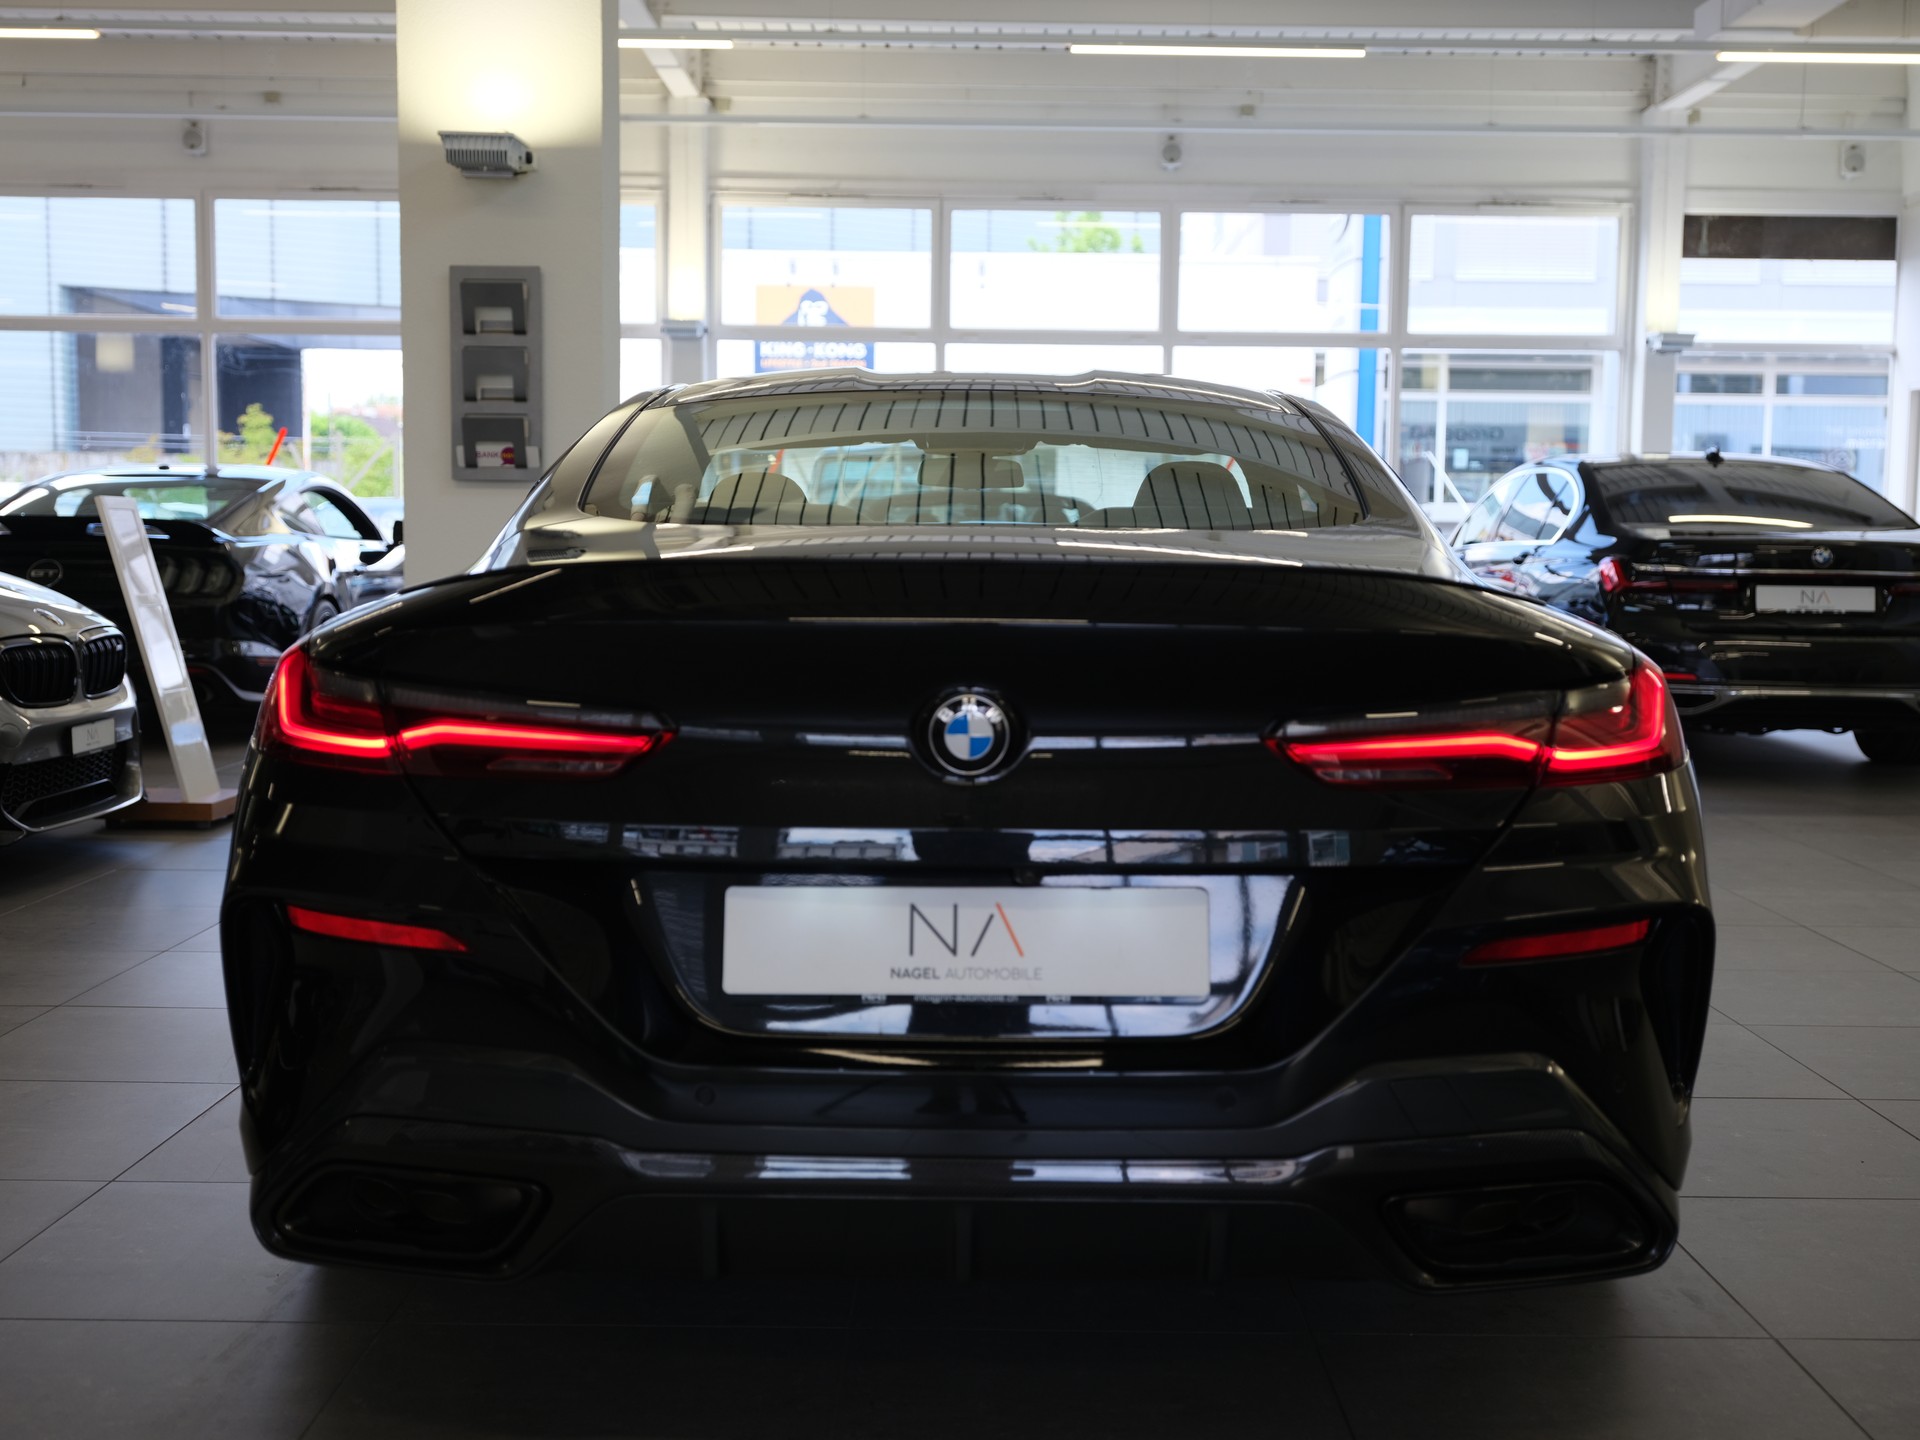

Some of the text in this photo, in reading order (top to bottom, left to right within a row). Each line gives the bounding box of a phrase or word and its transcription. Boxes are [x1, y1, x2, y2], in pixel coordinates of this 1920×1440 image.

[1800, 589, 1832, 605] NA
[909, 902, 1025, 958] NA
[889, 967, 1043, 981] NAGEL AUTOMOBILE
